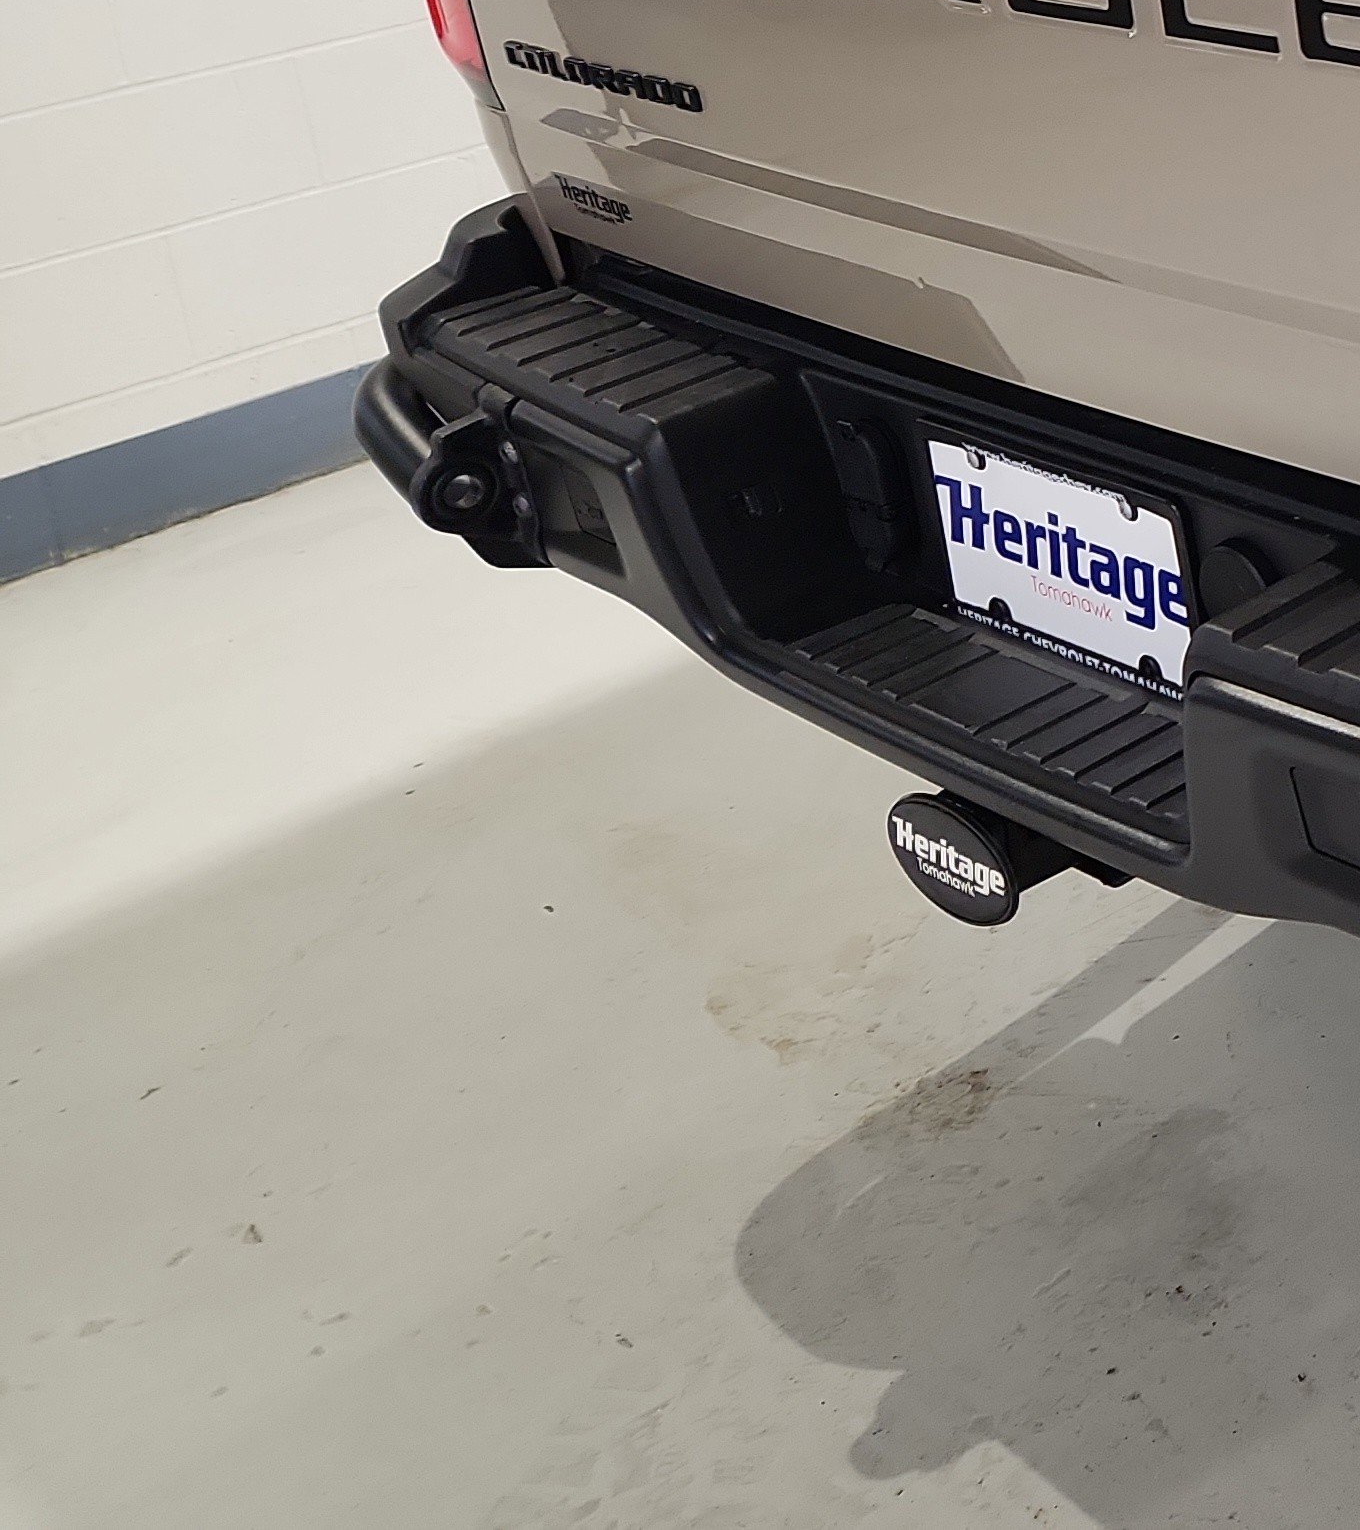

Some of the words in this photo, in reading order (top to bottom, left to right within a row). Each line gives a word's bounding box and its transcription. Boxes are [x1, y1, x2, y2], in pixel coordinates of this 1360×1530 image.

[503, 40, 703, 112] COLORADO
[554, 174, 633, 224] Heritage
[935, 474, 1189, 631] Heritage
[1031, 574, 1113, 622] Tomahawk
[892, 815, 1005, 897] Heritage
[916, 856, 976, 898] Tomahawk
